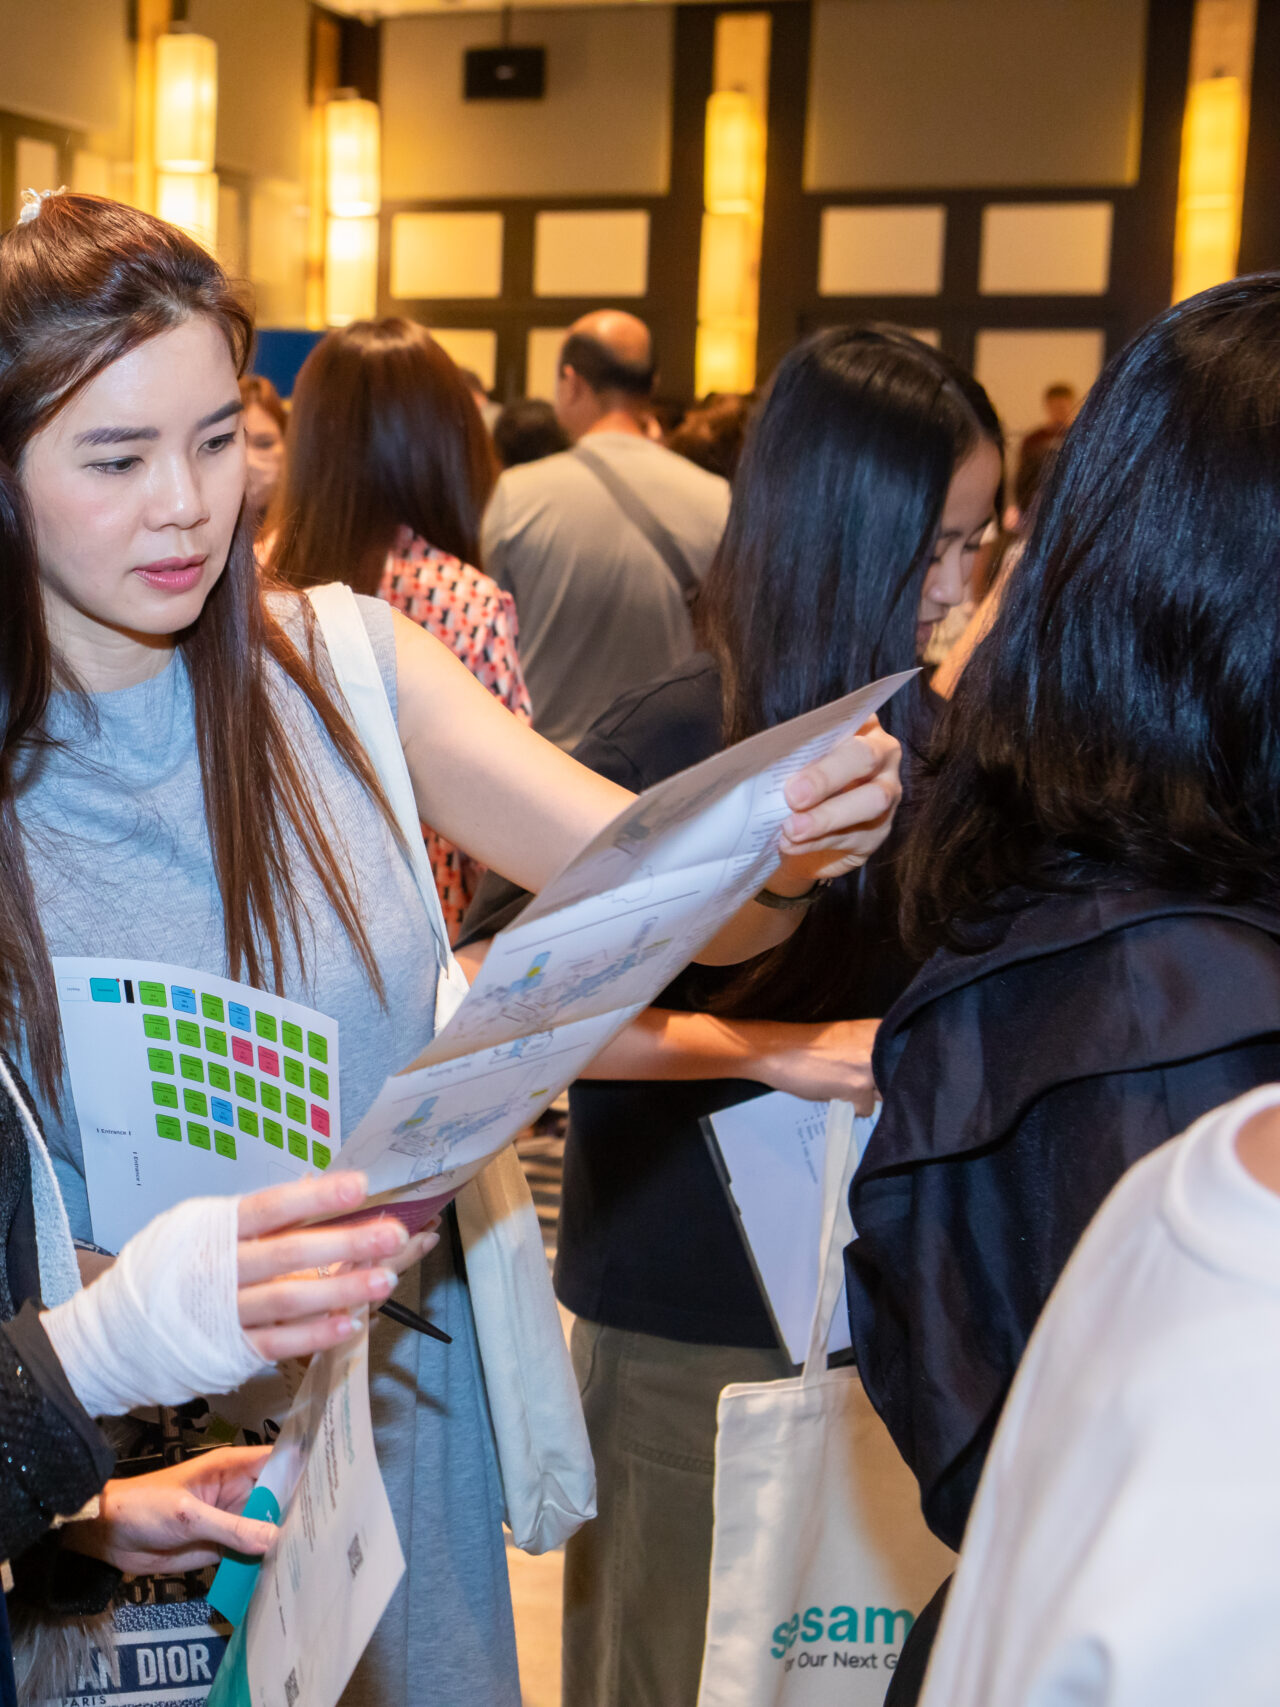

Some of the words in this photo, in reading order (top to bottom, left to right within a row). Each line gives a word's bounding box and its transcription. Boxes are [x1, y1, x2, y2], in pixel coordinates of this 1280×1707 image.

[133, 1155, 141, 1182] Entrance
[70, 1650, 122, 1691] AN
[136, 1643, 212, 1686] DIOR
[797, 1652, 827, 1668] Our
[833, 1652, 878, 1669] Next
